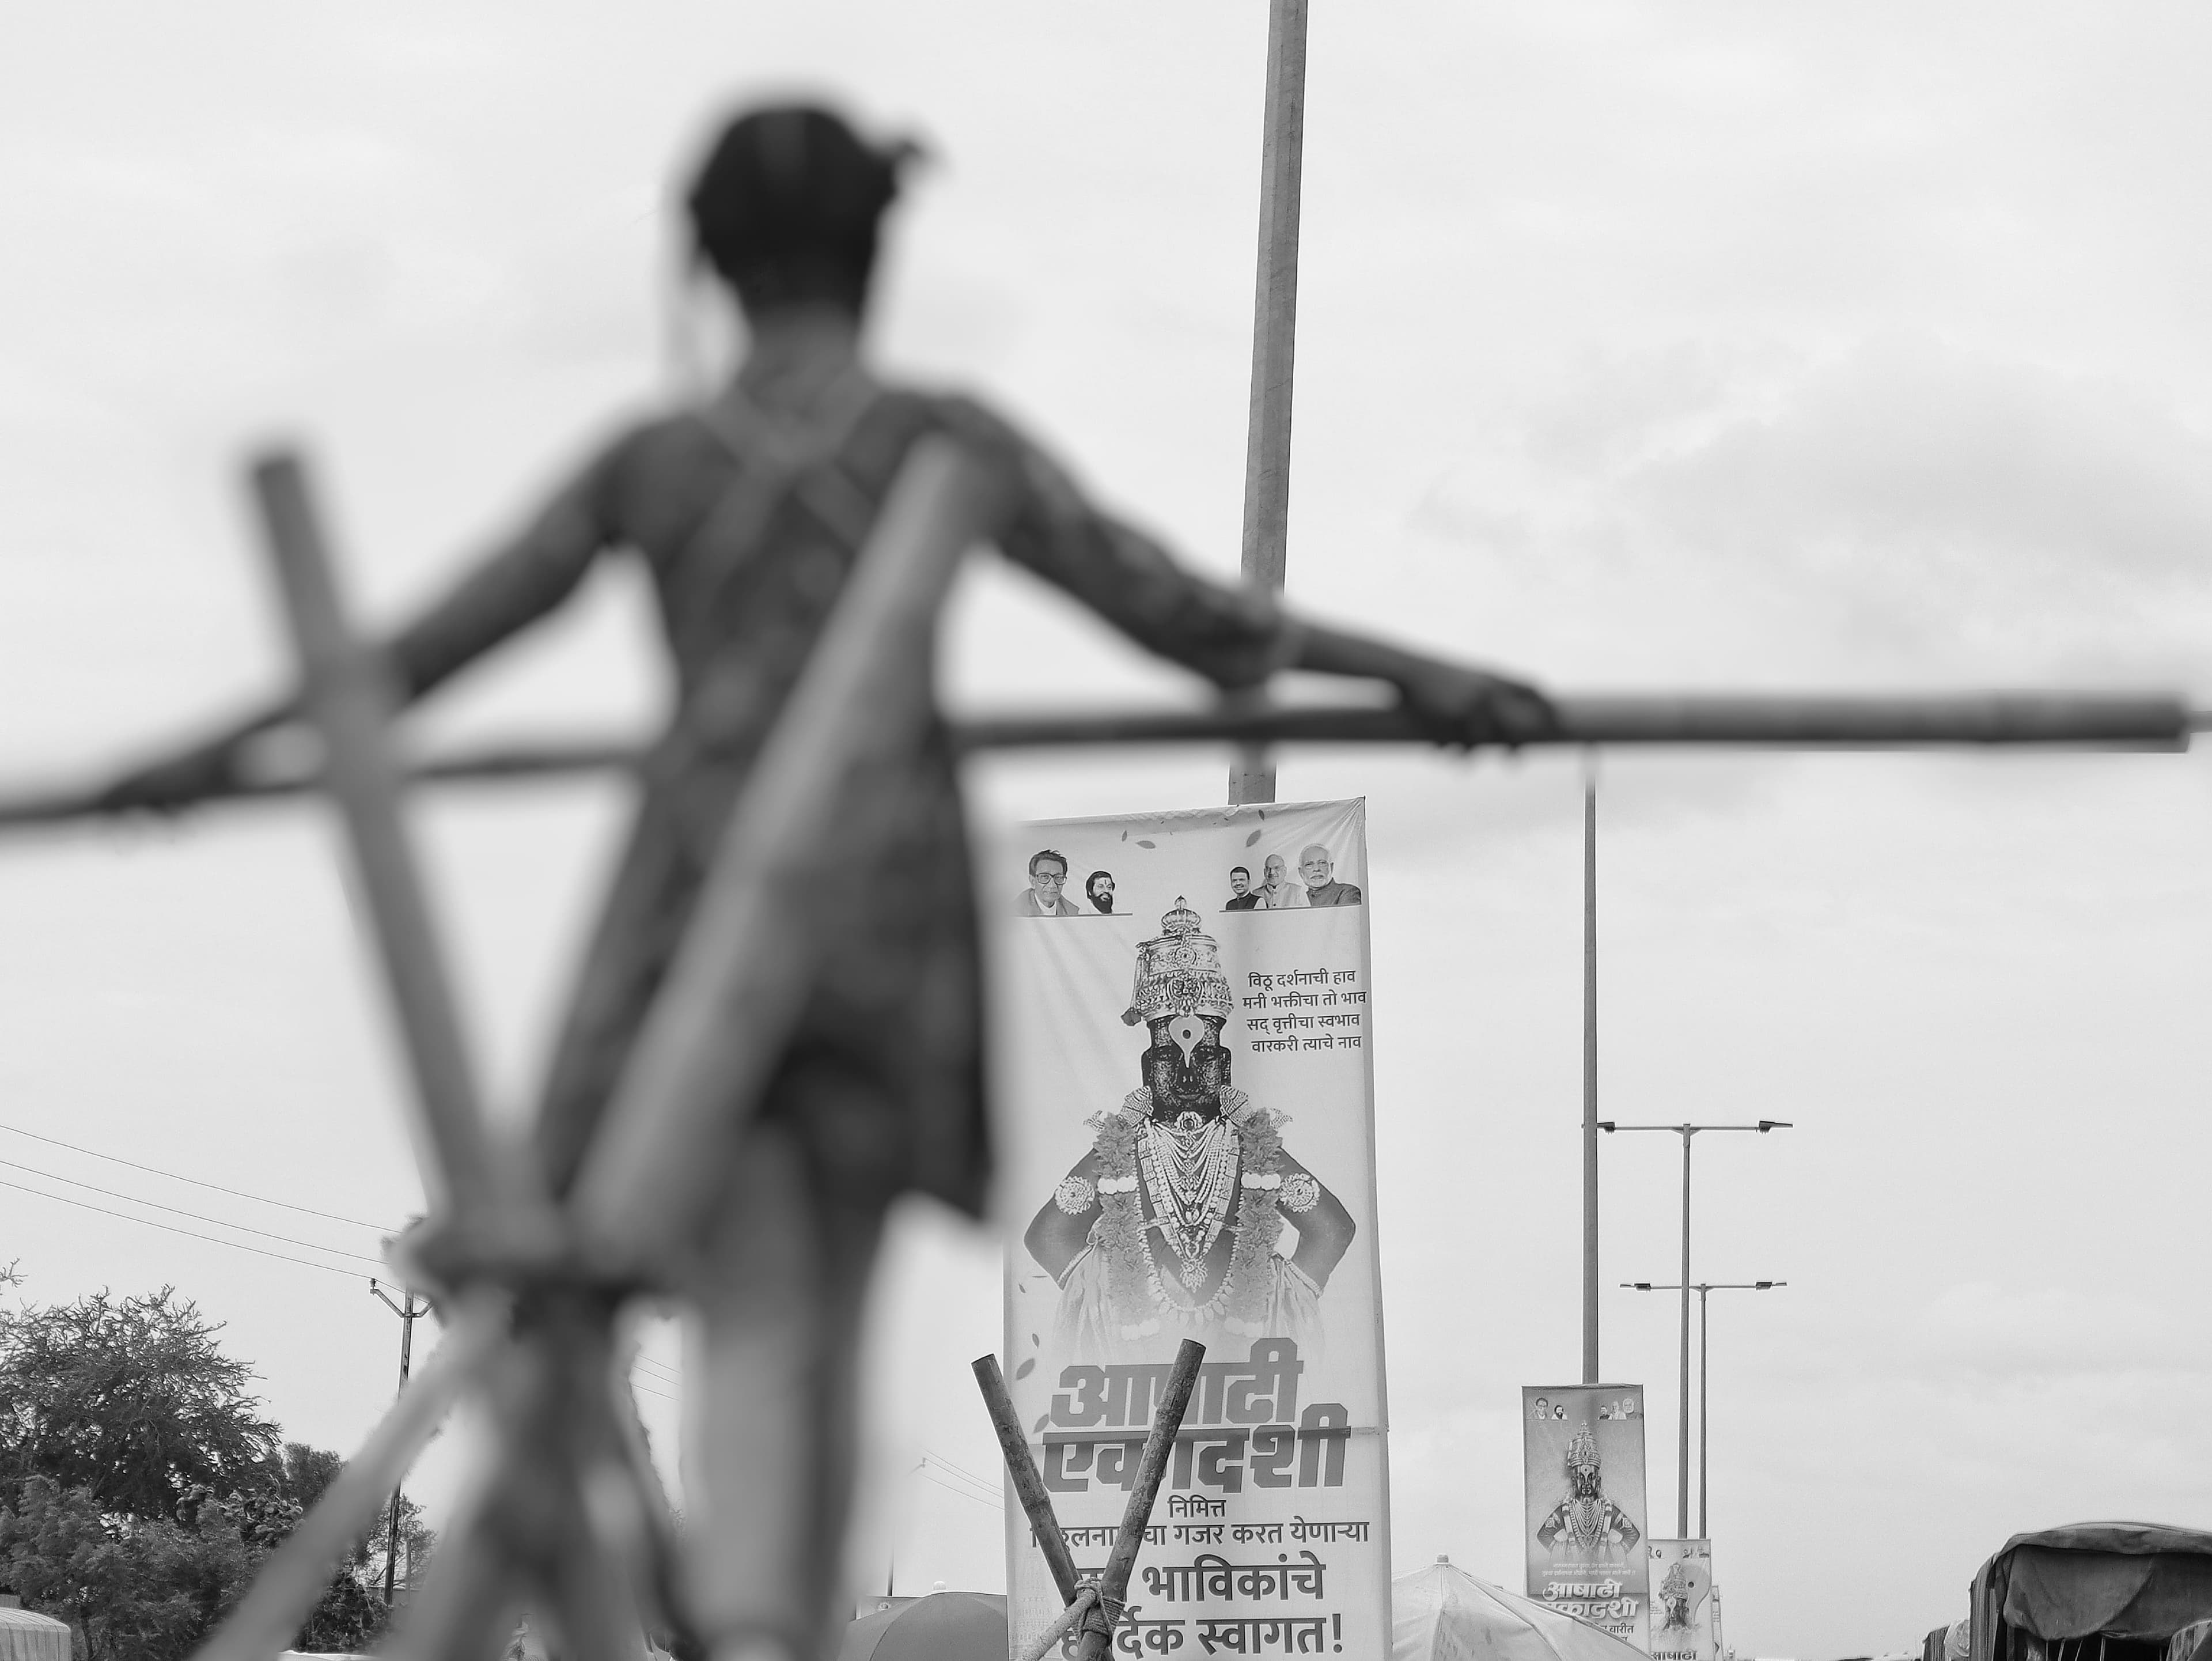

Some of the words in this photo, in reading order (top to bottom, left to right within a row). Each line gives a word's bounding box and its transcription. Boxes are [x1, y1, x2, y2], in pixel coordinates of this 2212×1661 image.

[1248, 971, 1273, 991] विठू
[1277, 968, 1329, 987] दर्शनाची
[1333, 971, 1355, 985] हाव
[1243, 993, 1267, 1009] मनी
[1271, 992, 1319, 1008] भक्तीचा
[1322, 989, 1337, 1005] तो
[1341, 992, 1367, 1004] भाव
[1247, 1018, 1270, 1034] सद्
[1272, 1013, 1314, 1033] वृत्तीचा
[1317, 1014, 1361, 1028] स्वभाव
[1251, 1035, 1298, 1052] वारकरी
[1302, 1034, 1334, 1051] त्याचे
[1338, 1036, 1362, 1049] नाव
[1167, 1494, 1226, 1518] निमित्त
[1173, 1524, 1225, 1545] गजर
[1231, 1523, 1284, 1544] करत
[1142, 1550, 1327, 1602] भाविकांचे
[1542, 1596, 1639, 1618] कादशी
[1196, 1613, 1343, 1655] स्वागत!
[1609, 1622, 1634, 1634] वारीत
